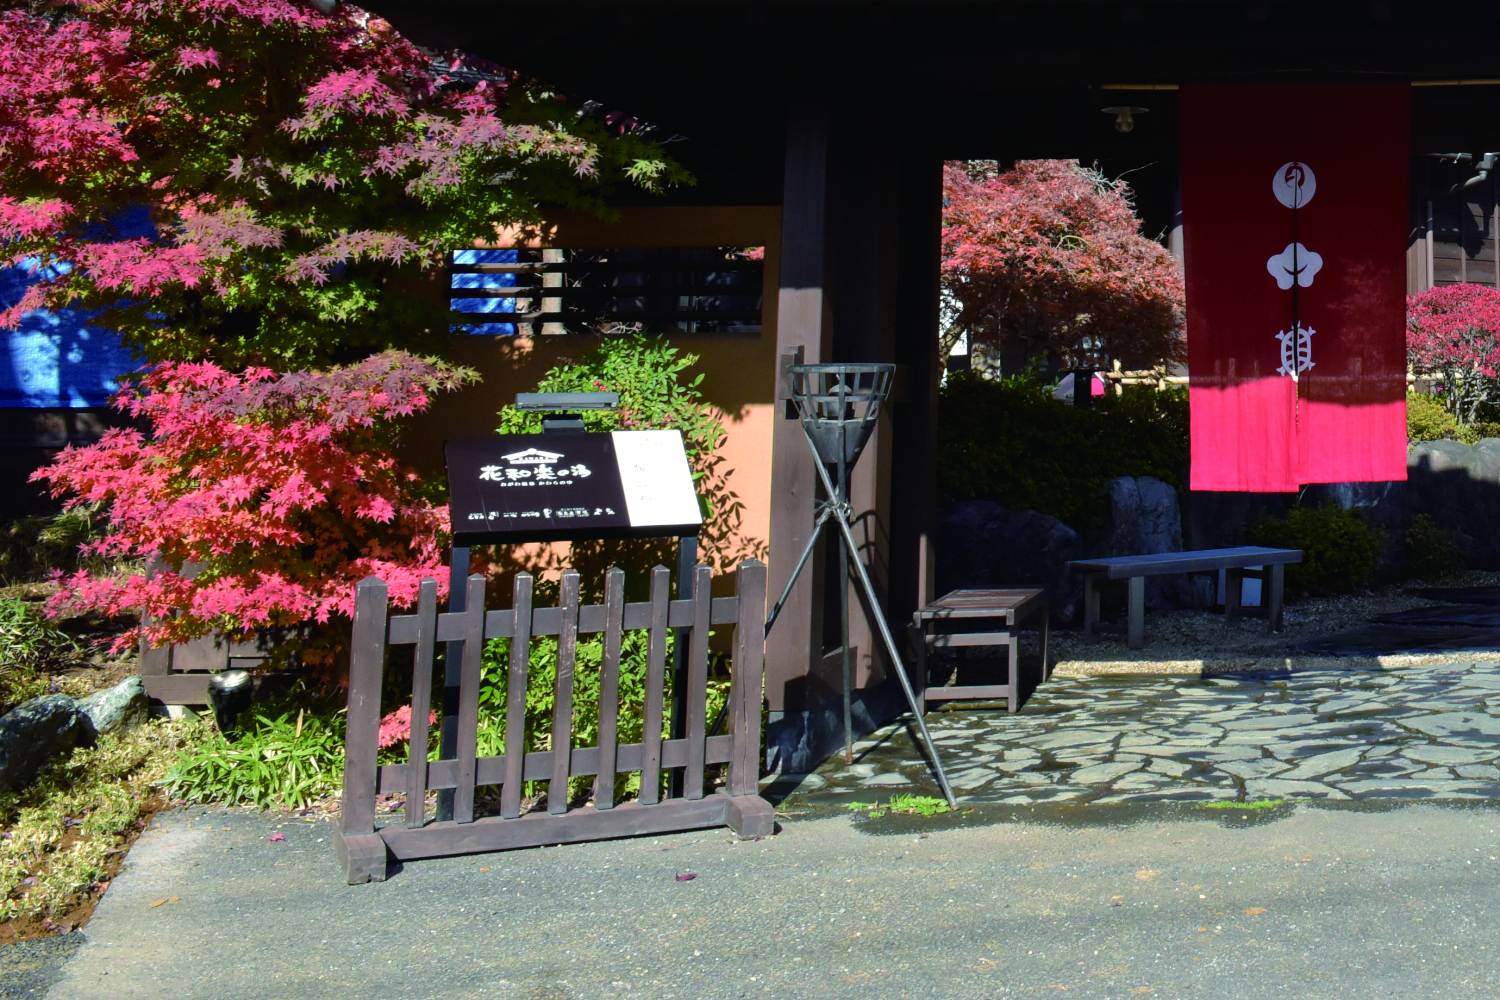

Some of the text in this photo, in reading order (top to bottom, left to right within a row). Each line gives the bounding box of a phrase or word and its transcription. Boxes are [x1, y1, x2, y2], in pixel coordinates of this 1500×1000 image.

[479, 463, 591, 481] 花和楽の湯
